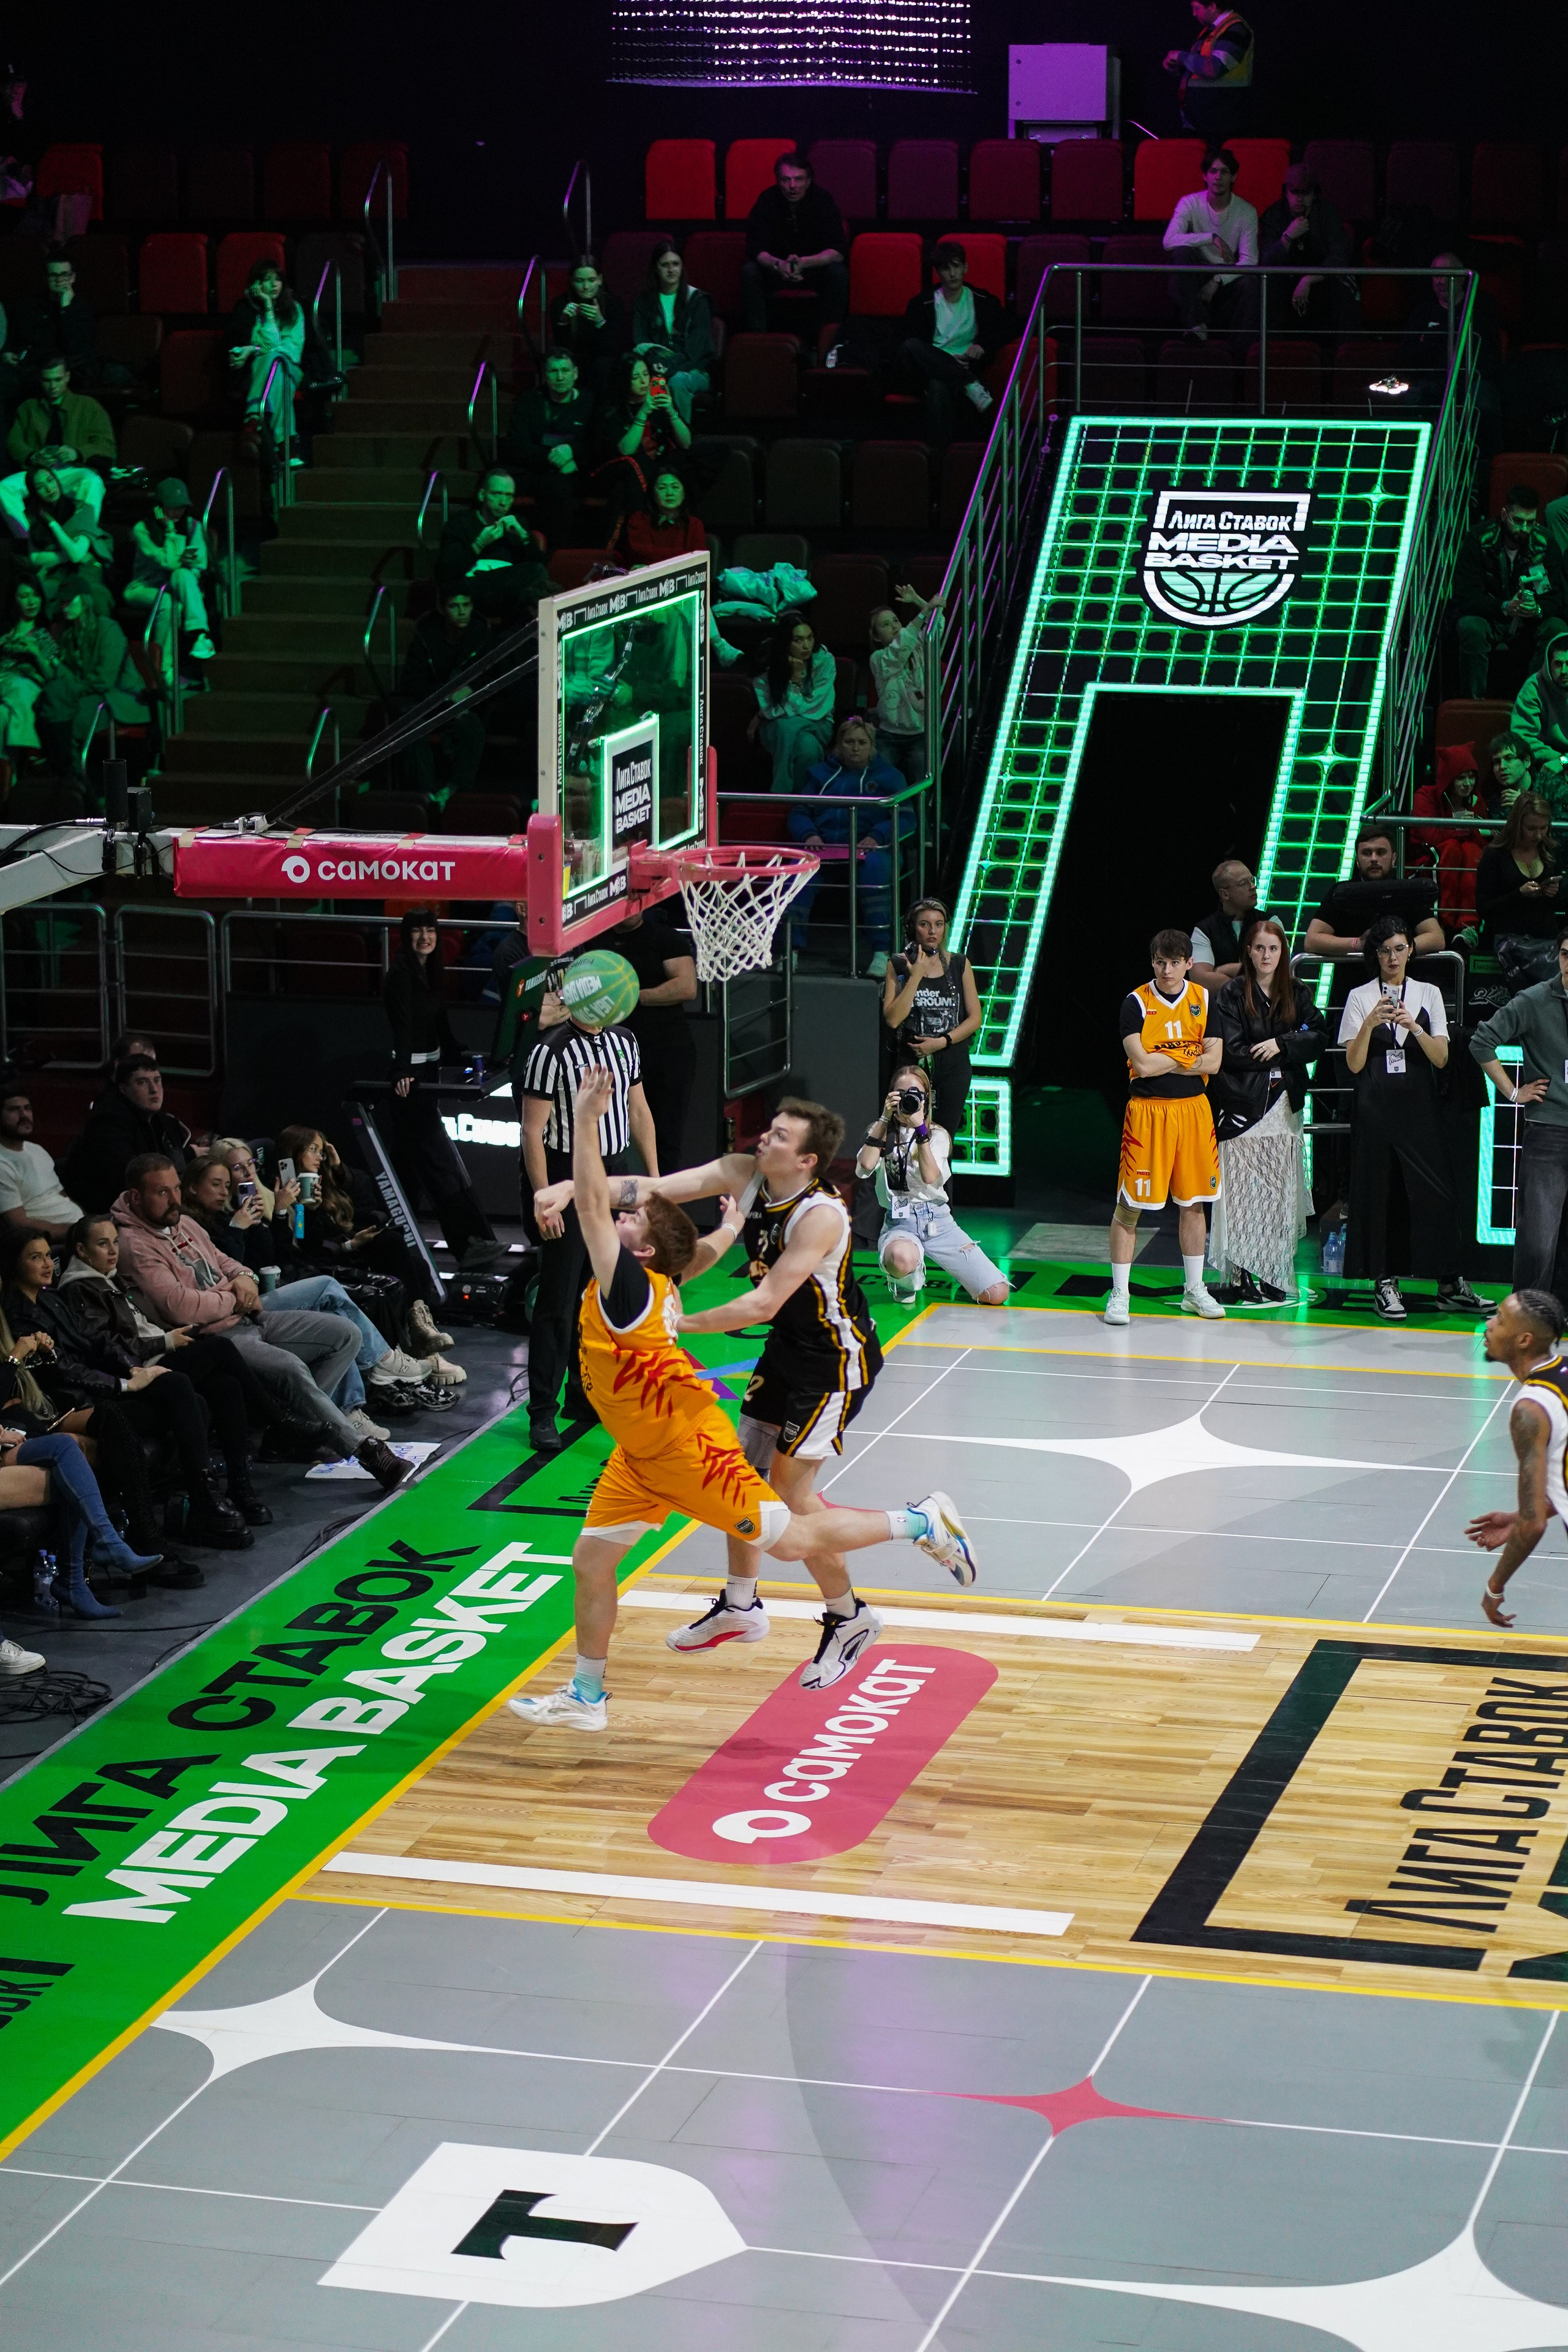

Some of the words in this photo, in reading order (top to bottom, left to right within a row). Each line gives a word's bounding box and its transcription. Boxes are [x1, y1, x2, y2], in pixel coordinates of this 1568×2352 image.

[1148, 532, 1299, 554] MEDIA
[1144, 552, 1299, 570] BASKET
[616, 783, 651, 816] MEDIA
[616, 803, 651, 834] BASKET
[914, 987, 940, 998] nder
[1164, 1020, 1183, 1039] 11
[1135, 1178, 1151, 1197] 11
[375, 1170, 417, 1248] YAMAGUCHI
[167, 1539, 483, 1732] СТАВОК
[61, 1744, 368, 1924] MEDIA
[285, 1541, 573, 1735] BASKET
